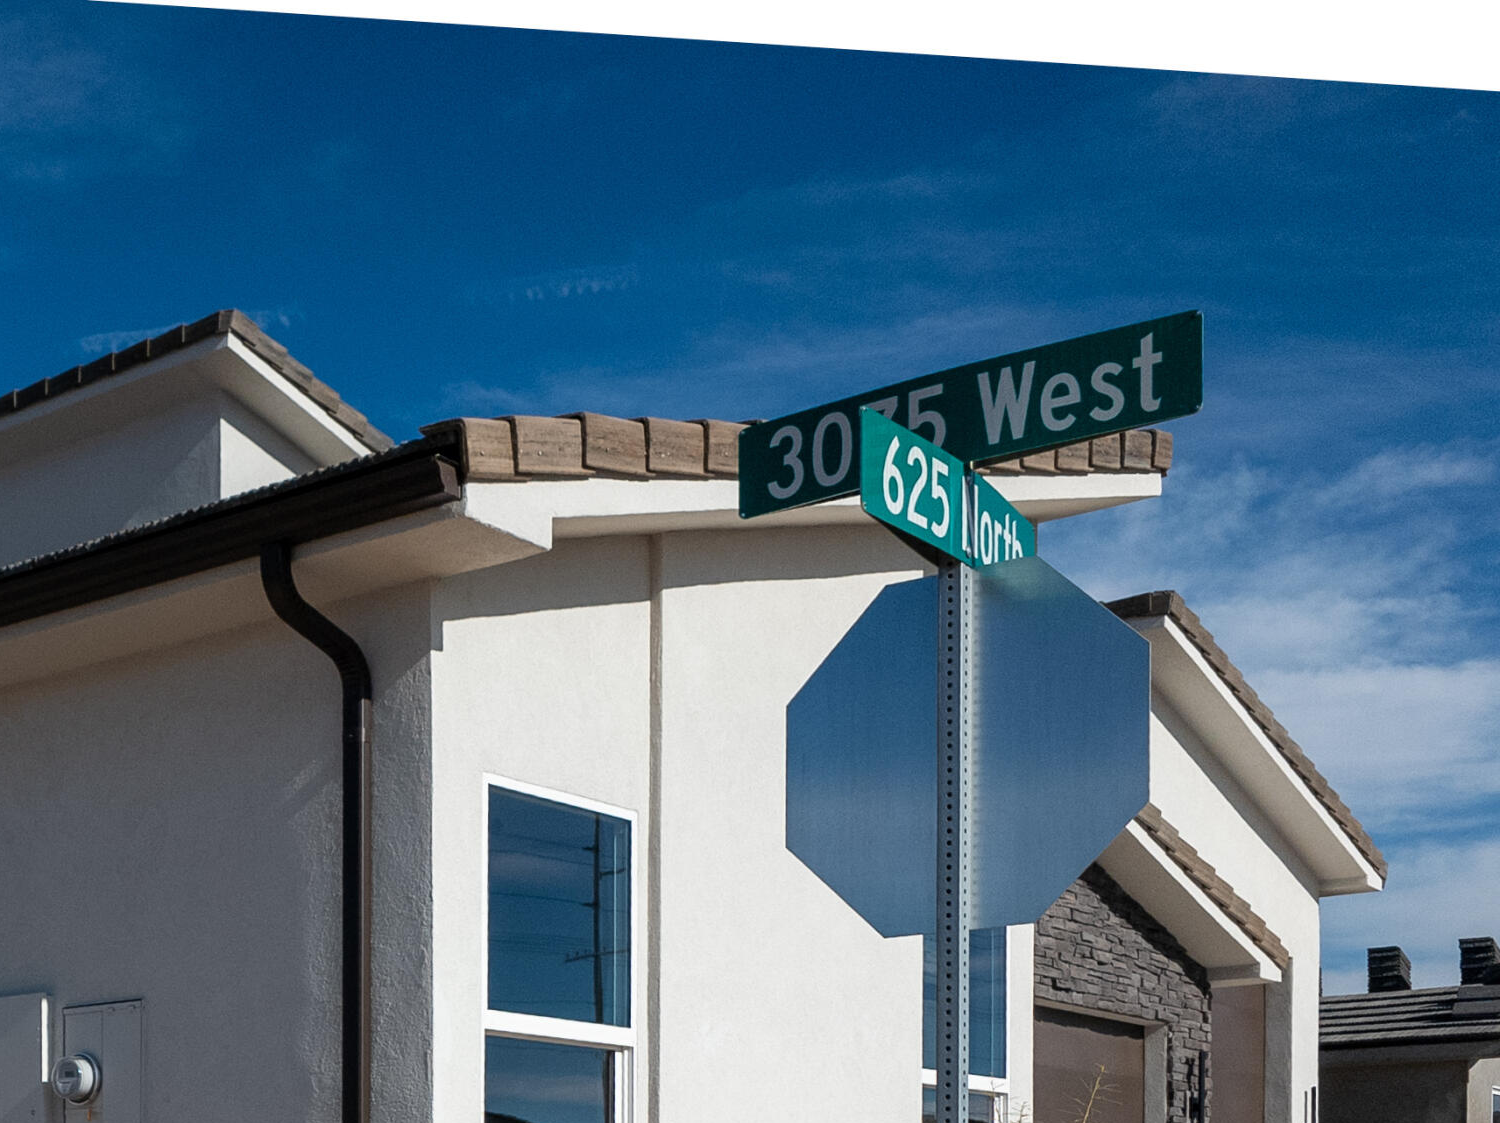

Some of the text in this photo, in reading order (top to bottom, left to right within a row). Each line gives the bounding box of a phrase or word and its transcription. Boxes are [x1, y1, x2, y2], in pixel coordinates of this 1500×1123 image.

[977, 332, 1163, 446] West
[882, 435, 1024, 566] 625 North
